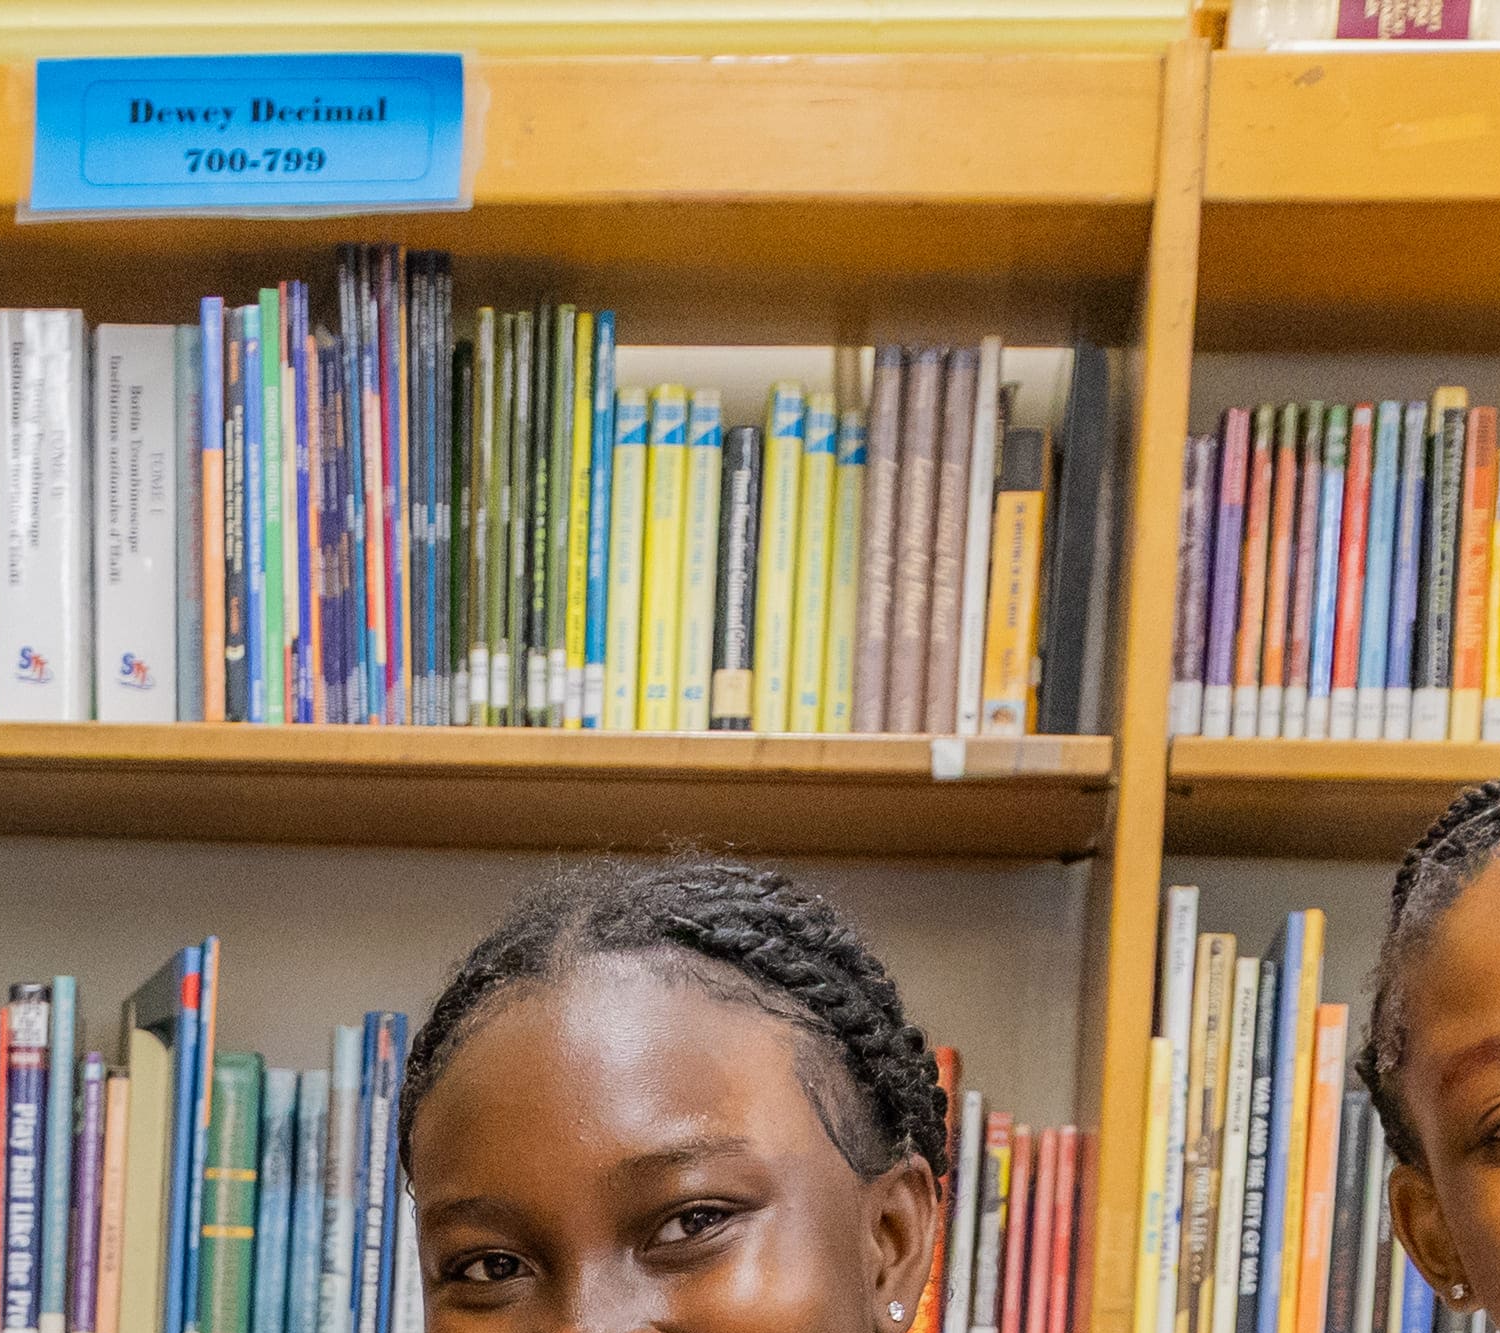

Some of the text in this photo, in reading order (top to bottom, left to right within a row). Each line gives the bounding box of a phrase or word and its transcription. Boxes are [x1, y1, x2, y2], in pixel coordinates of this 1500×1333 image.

[128, 96, 387, 130] Dewey Decimal
[184, 148, 327, 175] 700-799
[1251, 1078, 1270, 1114] WAR
[10, 1102, 37, 1151] Play
[1249, 1117, 1267, 1155] AND
[10, 1155, 36, 1200] Ball
[1247, 1158, 1266, 1190] THE
[9, 1203, 36, 1248] Like
[1243, 1231, 1260, 1254] OF
[8, 1252, 33, 1286] the
[1239, 1256, 1258, 1295] WAR
